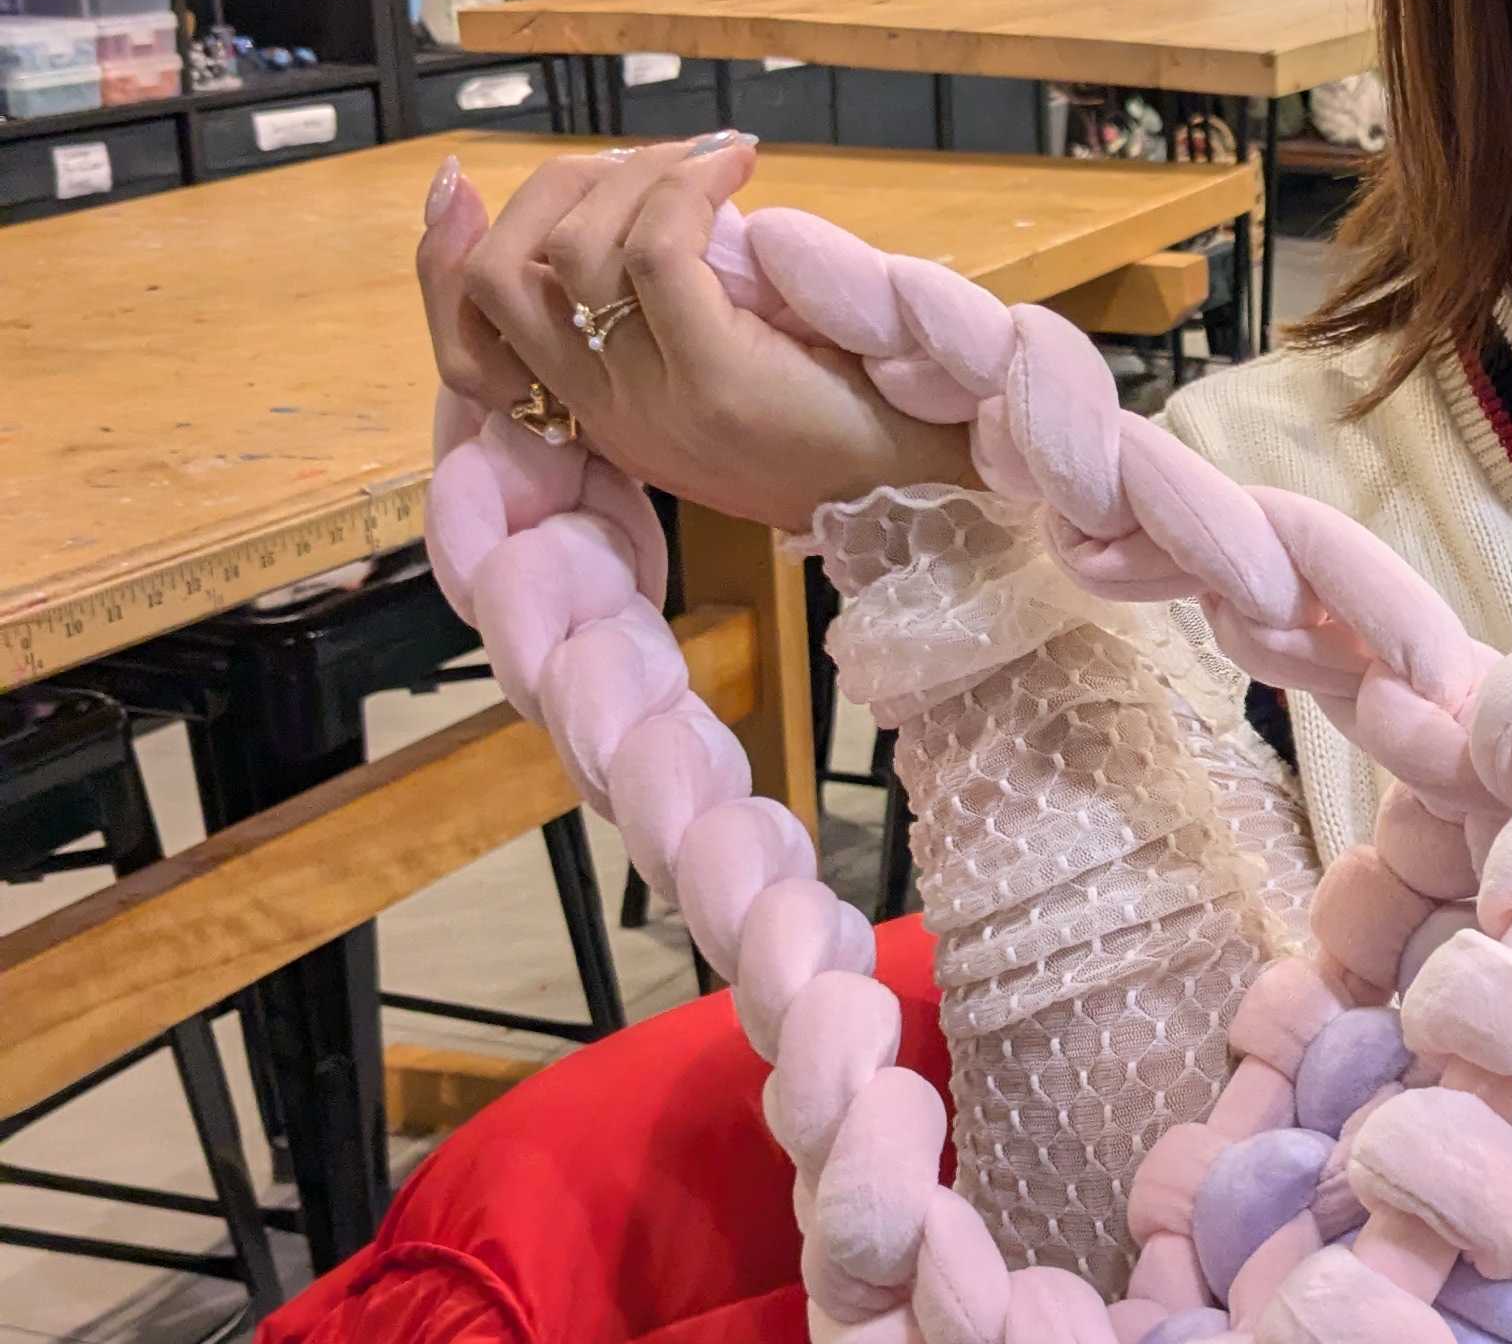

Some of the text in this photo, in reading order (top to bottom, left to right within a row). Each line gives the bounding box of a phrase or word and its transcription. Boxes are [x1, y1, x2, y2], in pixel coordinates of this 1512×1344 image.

[65, 619, 83, 638] 10
[107, 605, 123, 623] 11
[148, 591, 163, 608] 12
[262, 552, 275, 568] 15
[296, 541, 311, 557] 16
